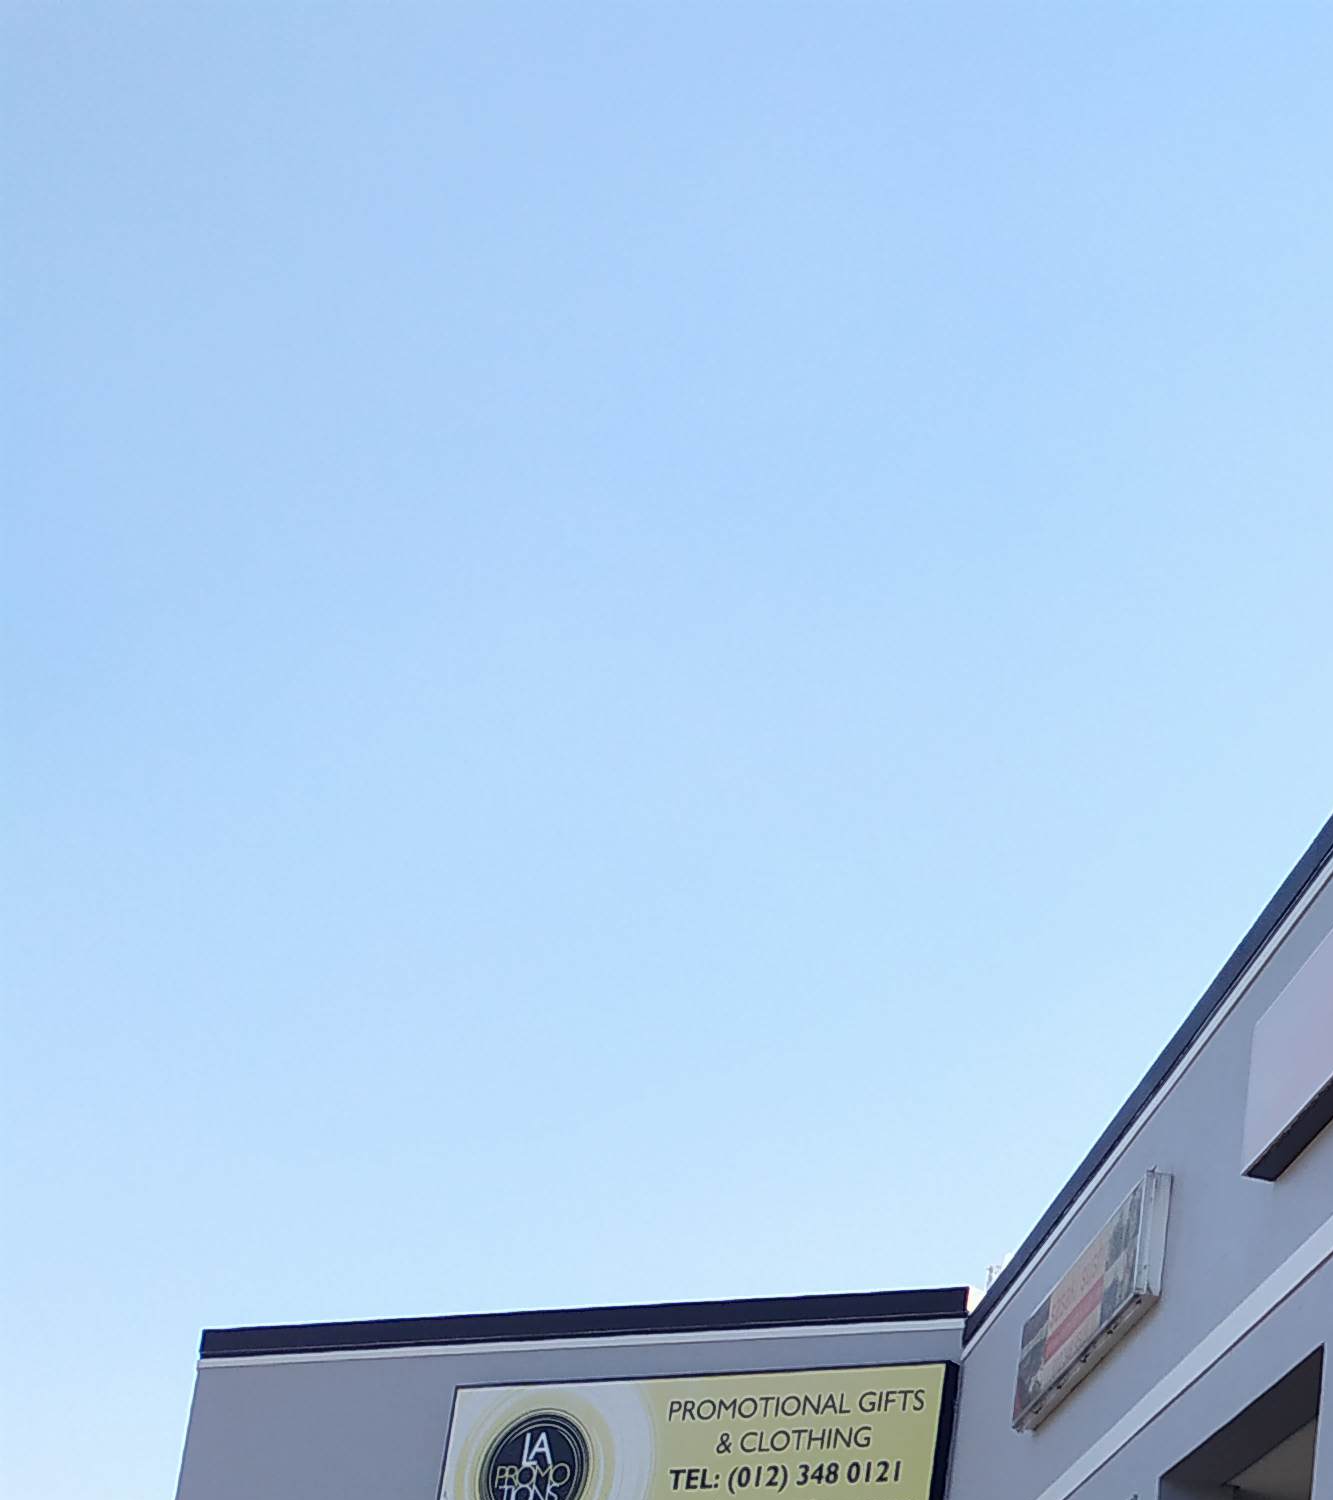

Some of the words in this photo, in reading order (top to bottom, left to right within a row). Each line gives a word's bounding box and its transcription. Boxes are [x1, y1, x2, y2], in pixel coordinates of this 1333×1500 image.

[668, 1393, 851, 1421] PROMOTIONAL
[859, 1389, 926, 1413] GIFTS
[522, 1432, 553, 1466] LA
[716, 1432, 733, 1454] &
[740, 1426, 873, 1453] CLOTHING
[494, 1462, 571, 1489] PROMO
[669, 1468, 720, 1491] TEL:
[727, 1464, 788, 1495] (012)
[796, 1462, 839, 1486] 348
[847, 1460, 902, 1484] 0121
